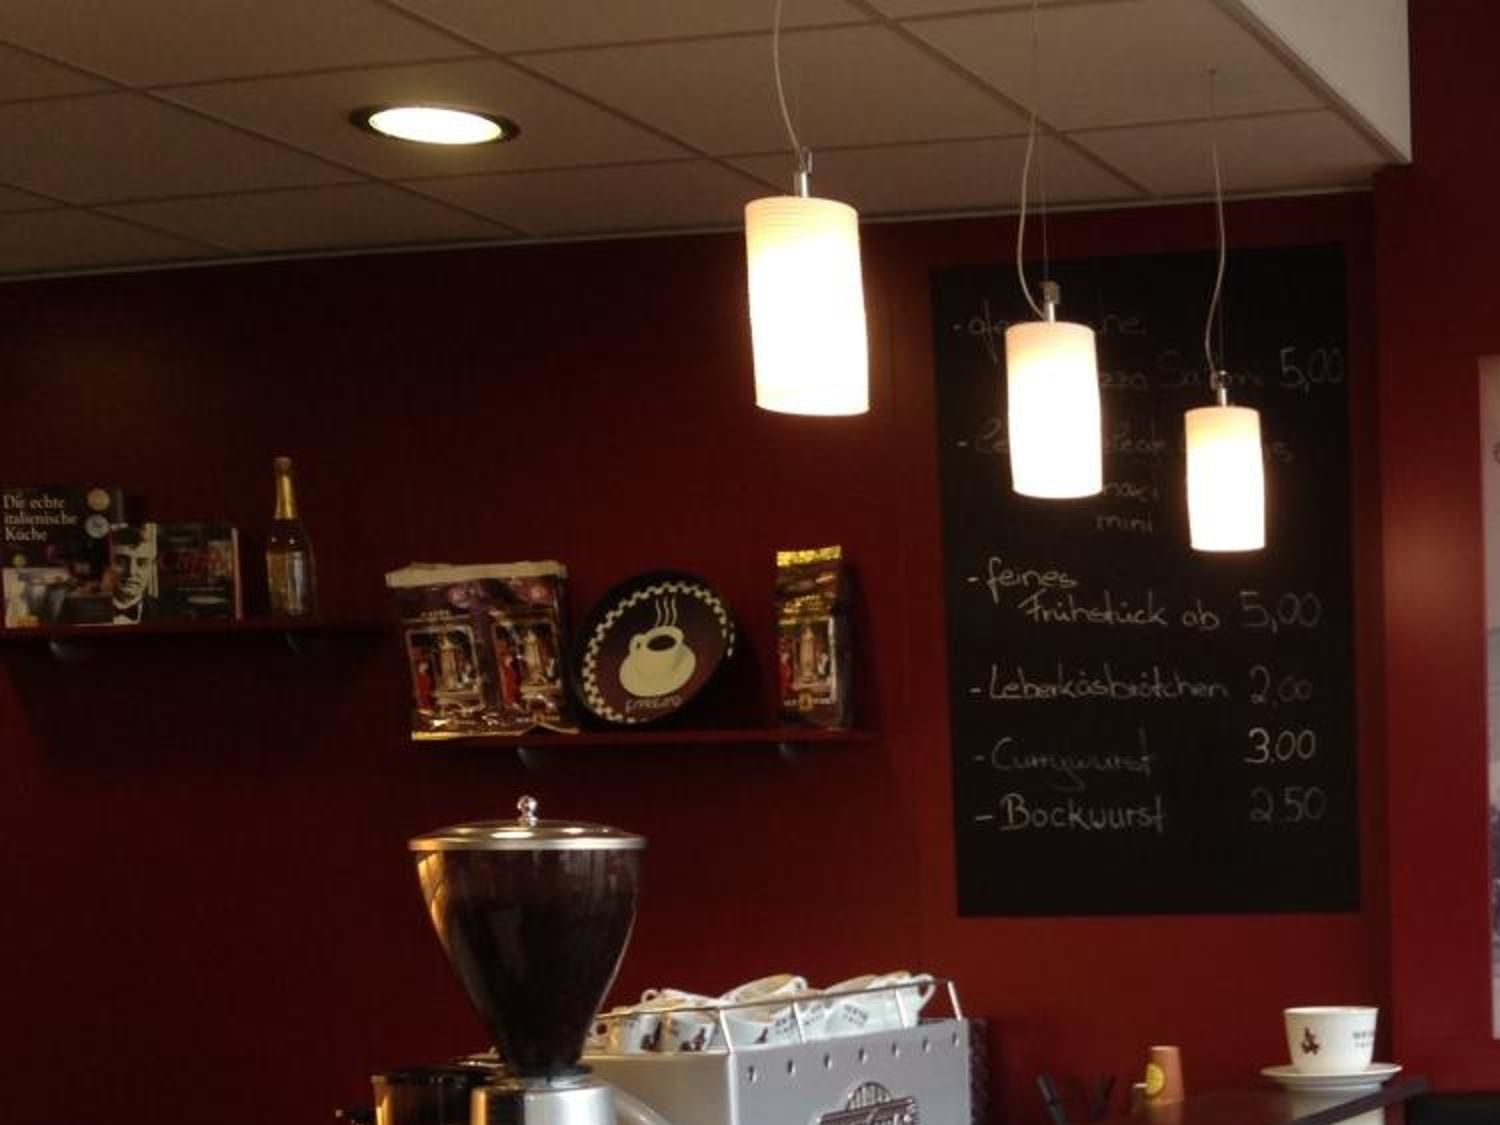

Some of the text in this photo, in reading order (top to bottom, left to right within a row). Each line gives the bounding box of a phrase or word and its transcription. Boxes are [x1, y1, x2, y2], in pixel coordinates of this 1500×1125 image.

[3, 492, 26, 509] Die
[985, 556, 1079, 604] feines
[1181, 599, 1220, 631] ab
[1000, 793, 1167, 834] Bockwurst
